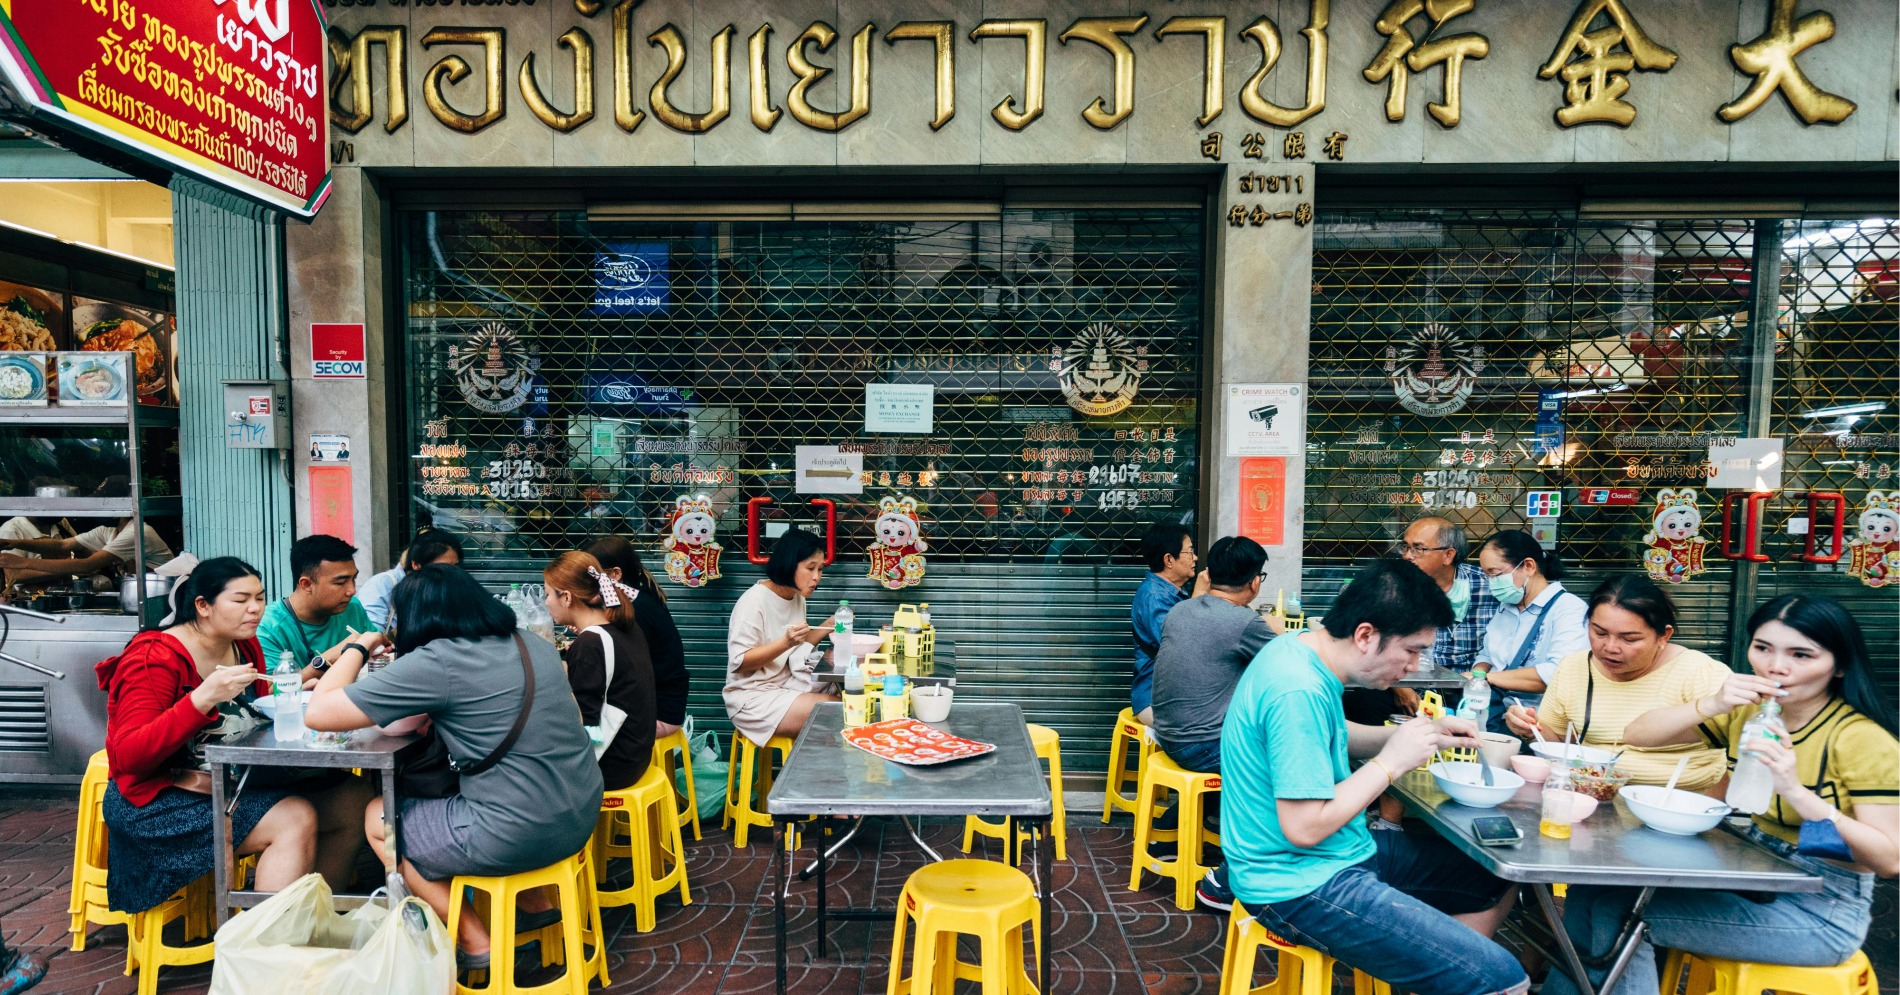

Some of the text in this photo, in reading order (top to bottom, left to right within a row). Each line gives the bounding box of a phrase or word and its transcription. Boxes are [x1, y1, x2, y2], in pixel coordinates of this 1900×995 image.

[216, 13, 318, 98] เยาวราช
[97, 28, 298, 159] รับซื้อทองเก่าทุกชนิด
[1239, 170, 1292, 194] สาขา
[315, 362, 362, 374] SECOM
[650, 462, 735, 483] ยินดีต้อนรับ
[1627, 455, 1718, 478] ยินดีต้อนรับ
